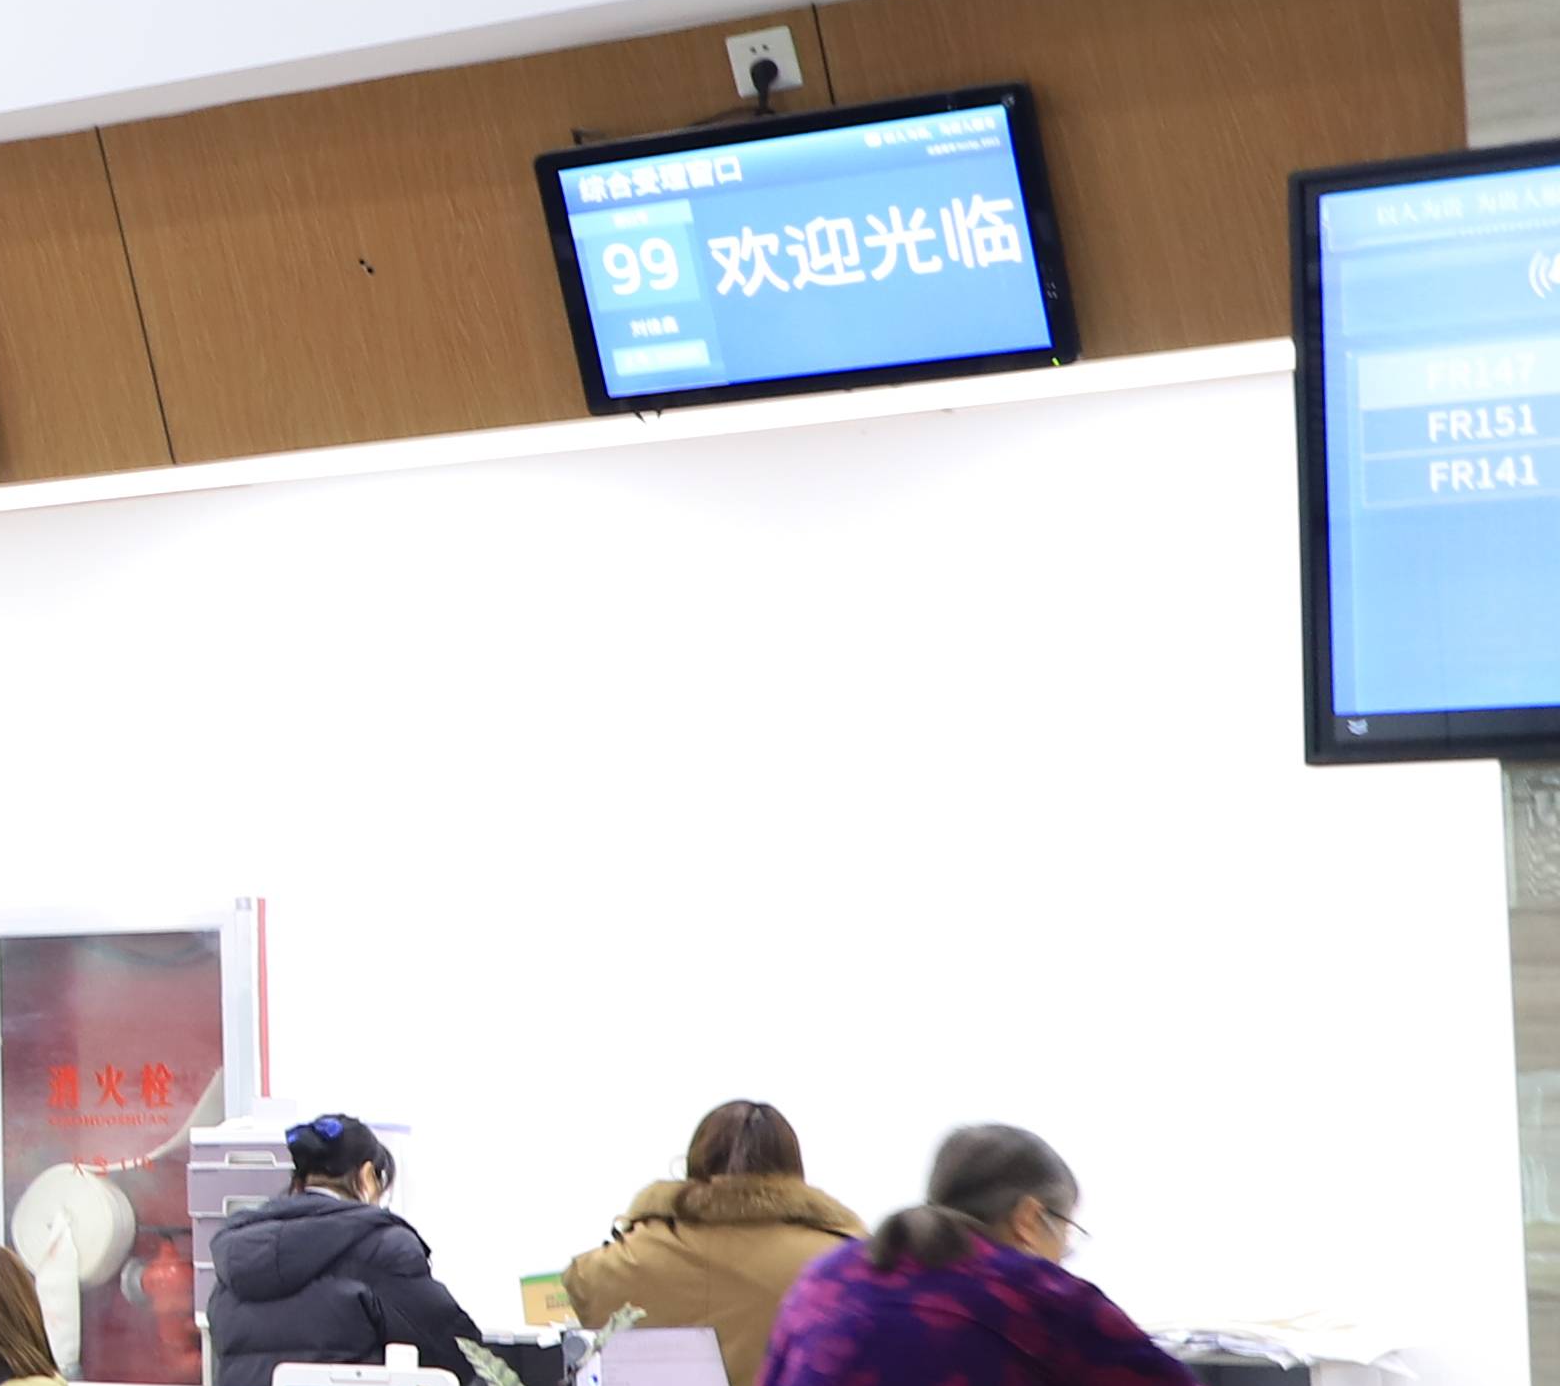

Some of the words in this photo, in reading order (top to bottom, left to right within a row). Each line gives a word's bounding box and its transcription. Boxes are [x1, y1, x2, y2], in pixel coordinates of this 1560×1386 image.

[602, 237, 680, 295] 99
[707, 194, 1023, 298] 欢迎光临
[1427, 404, 1539, 443] FR151
[1429, 454, 1539, 493] FR141
